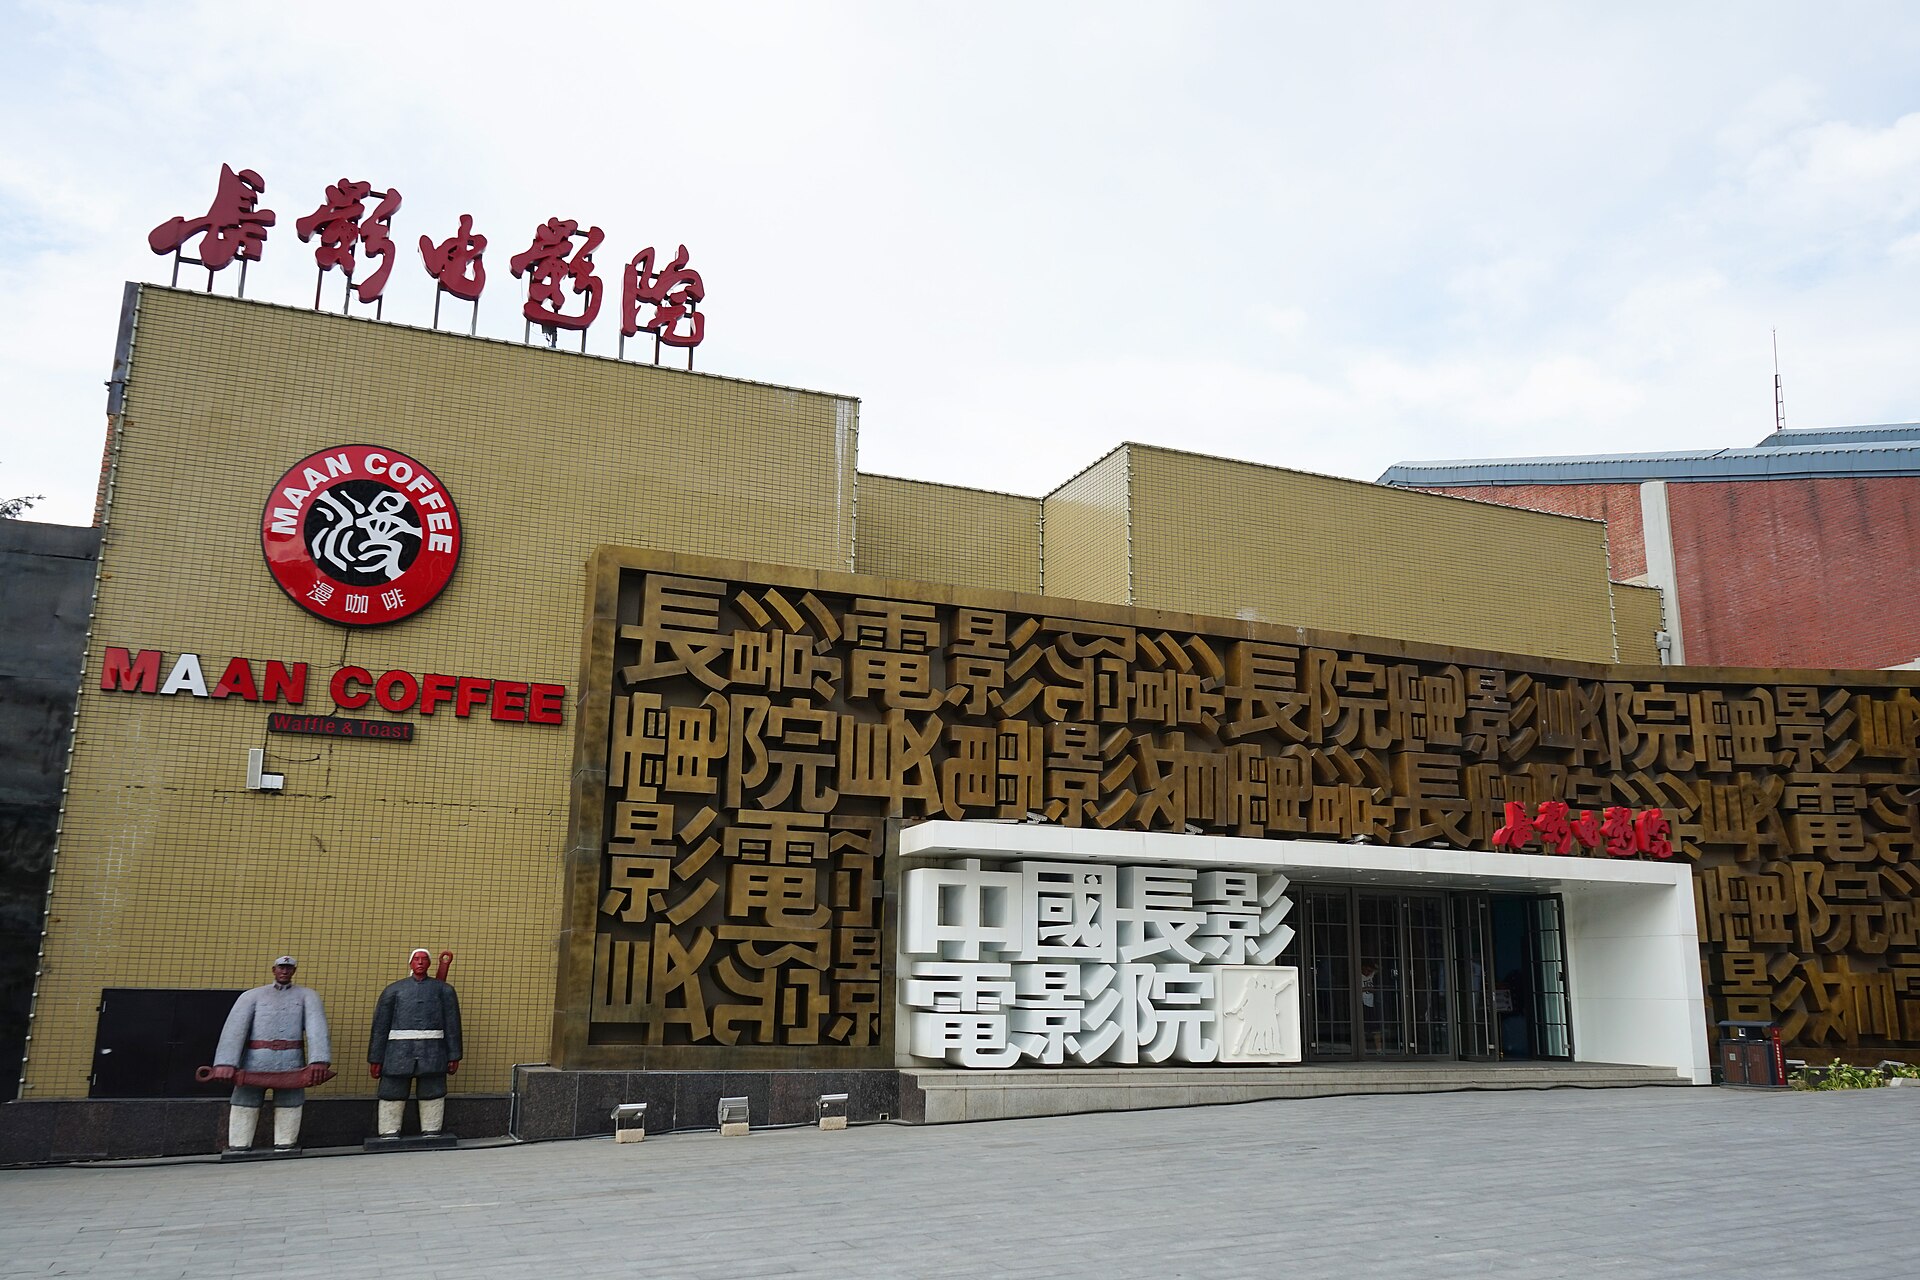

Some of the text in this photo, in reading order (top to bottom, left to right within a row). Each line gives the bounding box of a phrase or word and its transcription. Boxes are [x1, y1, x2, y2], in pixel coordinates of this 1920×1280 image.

[271, 453, 453, 554] MAAN COFFEE
[306, 580, 407, 614] 漫咖啡
[100, 646, 566, 726] MAAN COFFEE
[273, 715, 410, 739] Waffle & Toast
[903, 858, 1296, 964] 中國長影
[903, 962, 1219, 1069] 電影院
